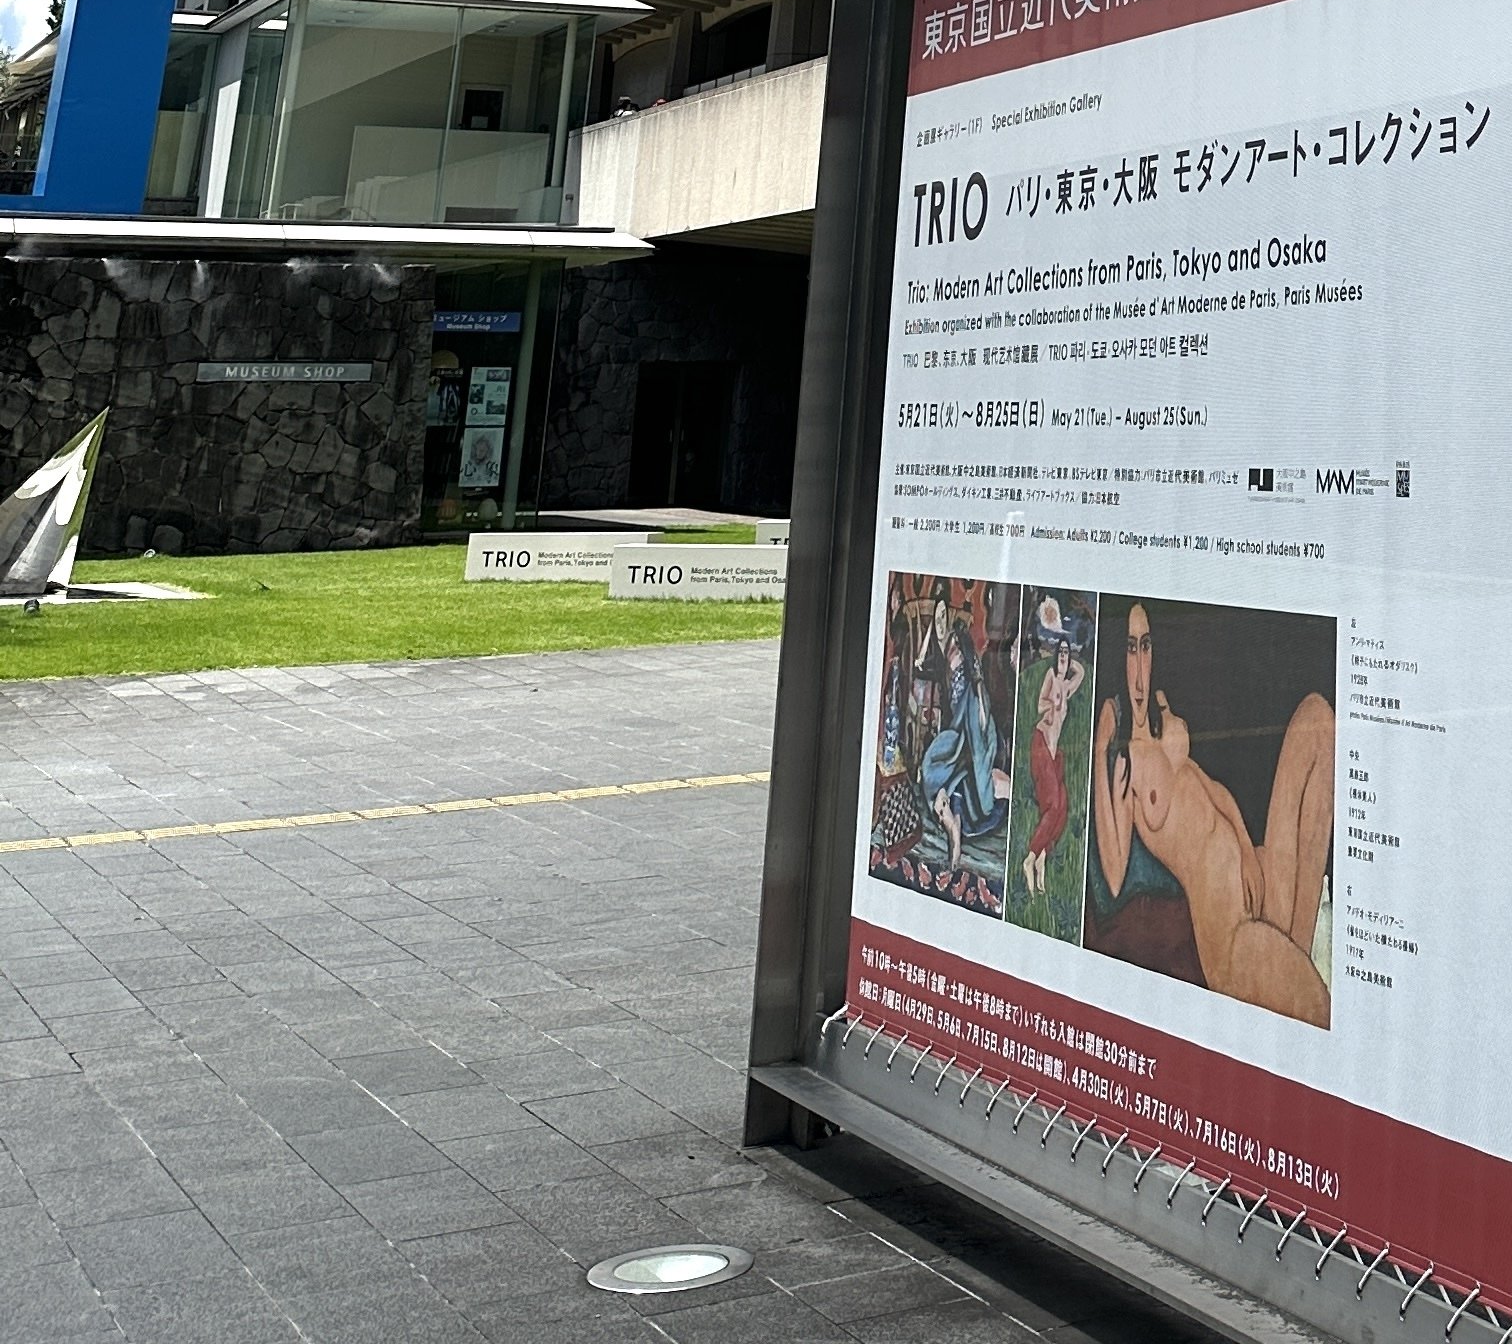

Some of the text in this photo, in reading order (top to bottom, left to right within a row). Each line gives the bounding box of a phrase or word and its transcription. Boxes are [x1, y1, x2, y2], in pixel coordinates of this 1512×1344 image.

[992, 108, 1023, 132] Special
[1024, 99, 1067, 123] Exhibition
[1069, 92, 1103, 113] Gallery
[913, 100, 1491, 247] TRIO パリ・東京・大阪 モダンアート・コレクション
[908, 234, 1327, 304] Trio: Modern Art Collections from Paris, Tokyo and Osaka
[904, 317, 940, 336] Exhibition
[942, 314, 982, 336] organized
[985, 312, 1002, 330] with
[1004, 311, 1016, 328] the
[1019, 305, 1081, 326] collaboration
[1083, 303, 1093, 321] of
[1096, 302, 1111, 320] the
[1113, 297, 1146, 319] Musée
[1177, 293, 1227, 314] Moderne
[1231, 290, 1246, 311] de
[1250, 287, 1280, 310] Paris,
[1284, 285, 1311, 306] Paris
[1314, 278, 1363, 303] Musées
[1049, 343, 1068, 361] TRIO
[1160, 334, 1177, 358] 아트
[224, 365, 345, 378] MUSEUM SHOP
[1051, 408, 1070, 430] May
[1124, 405, 1161, 431] August
[1316, 468, 1355, 495] MAM
[1118, 531, 1148, 548] College
[1150, 533, 1181, 548] students
[1216, 537, 1235, 555] High
[1236, 538, 1264, 555] school
[1266, 540, 1300, 557] students
[1303, 542, 1325, 559] ¥700
[482, 550, 531, 568] TRIO
[691, 567, 720, 575] Modern
[721, 567, 734, 575] Art
[628, 565, 683, 585] TRIO
[731, 575, 754, 585] Tokyo
